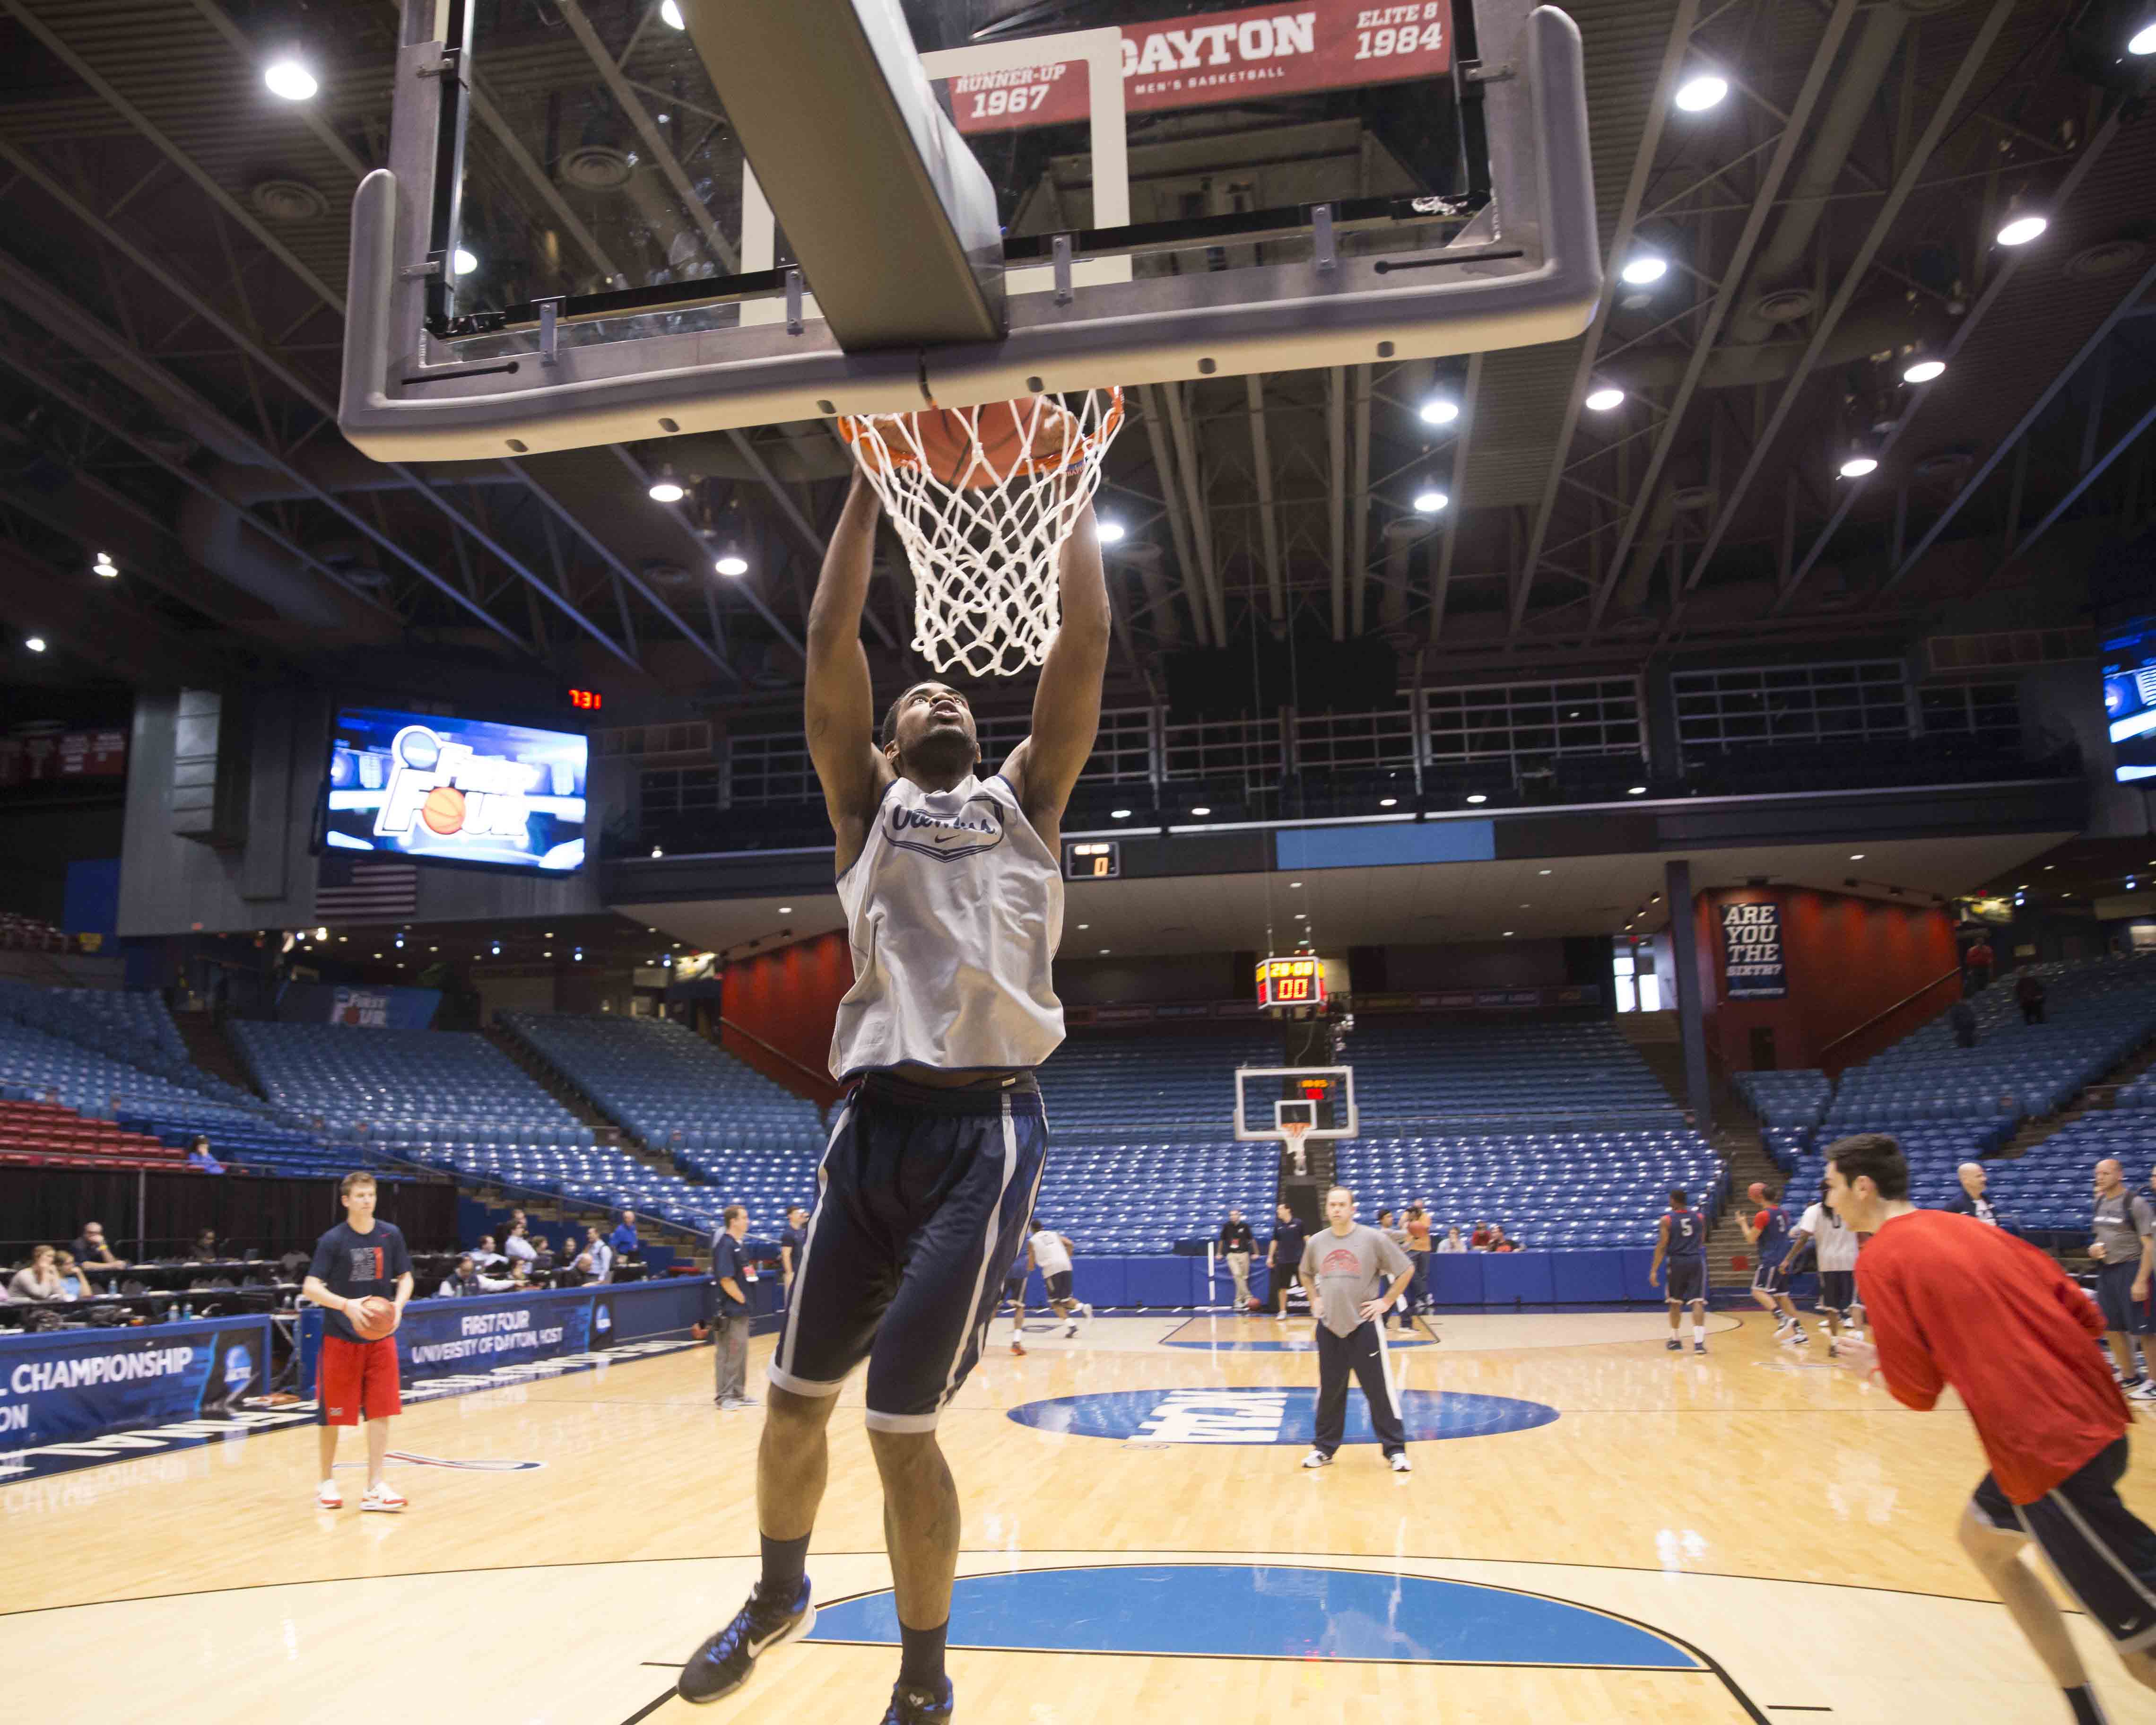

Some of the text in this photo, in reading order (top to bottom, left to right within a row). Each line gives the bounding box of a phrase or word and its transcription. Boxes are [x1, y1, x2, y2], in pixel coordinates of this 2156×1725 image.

[1356, 1, 1438, 28] ELITE 8
[1354, 22, 1442, 60] 1984
[955, 64, 1067, 94] RUNNER-UP
[1135, 66, 1285, 95] MEN'S BASKETBALL
[971, 84, 1050, 118] 1967
[1722, 906, 1775, 925] ARE
[1726, 925, 1778, 943] YOU
[1728, 944, 1779, 963] THE
[1278, 978, 1308, 999] 00
[1680, 1218, 1693, 1237] 5
[1776, 1215, 1786, 1232] 3
[461, 1310, 530, 1336] FIRST FOUR
[412, 1339, 478, 1363] UNIVERSITY
[478, 1336, 495, 1354] OF
[11, 1347, 193, 1394] CHAMPIONSHIP
